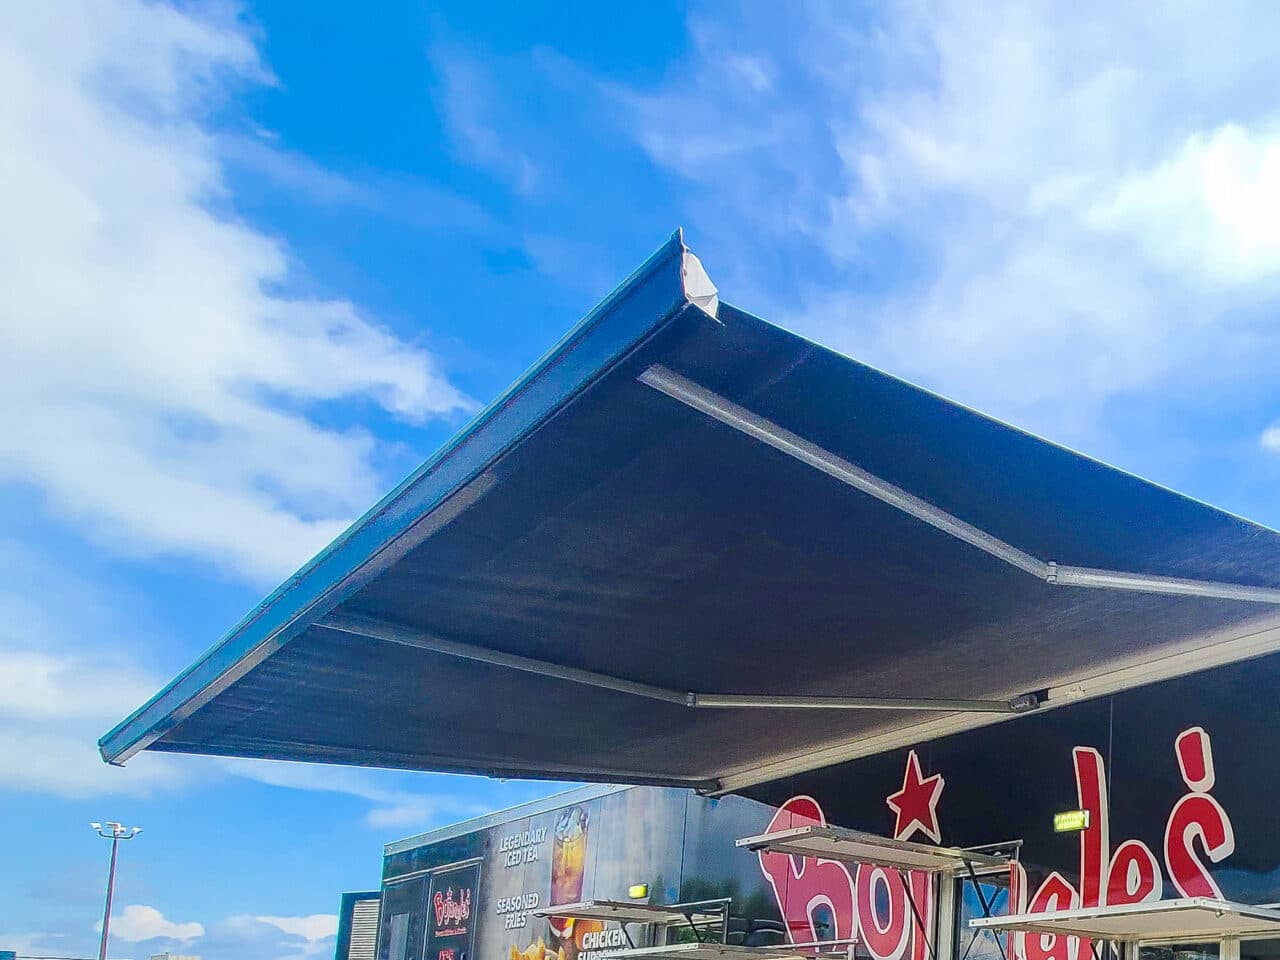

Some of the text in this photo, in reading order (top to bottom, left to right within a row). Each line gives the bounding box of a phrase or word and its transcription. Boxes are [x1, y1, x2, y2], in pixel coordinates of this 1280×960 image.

[500, 827, 548, 853] LEGENDARY
[504, 847, 539, 868] ICED TEA
[496, 892, 539, 915] SEASONED
[505, 912, 527, 930] FRIES
[582, 929, 627, 950] CHICKEN
